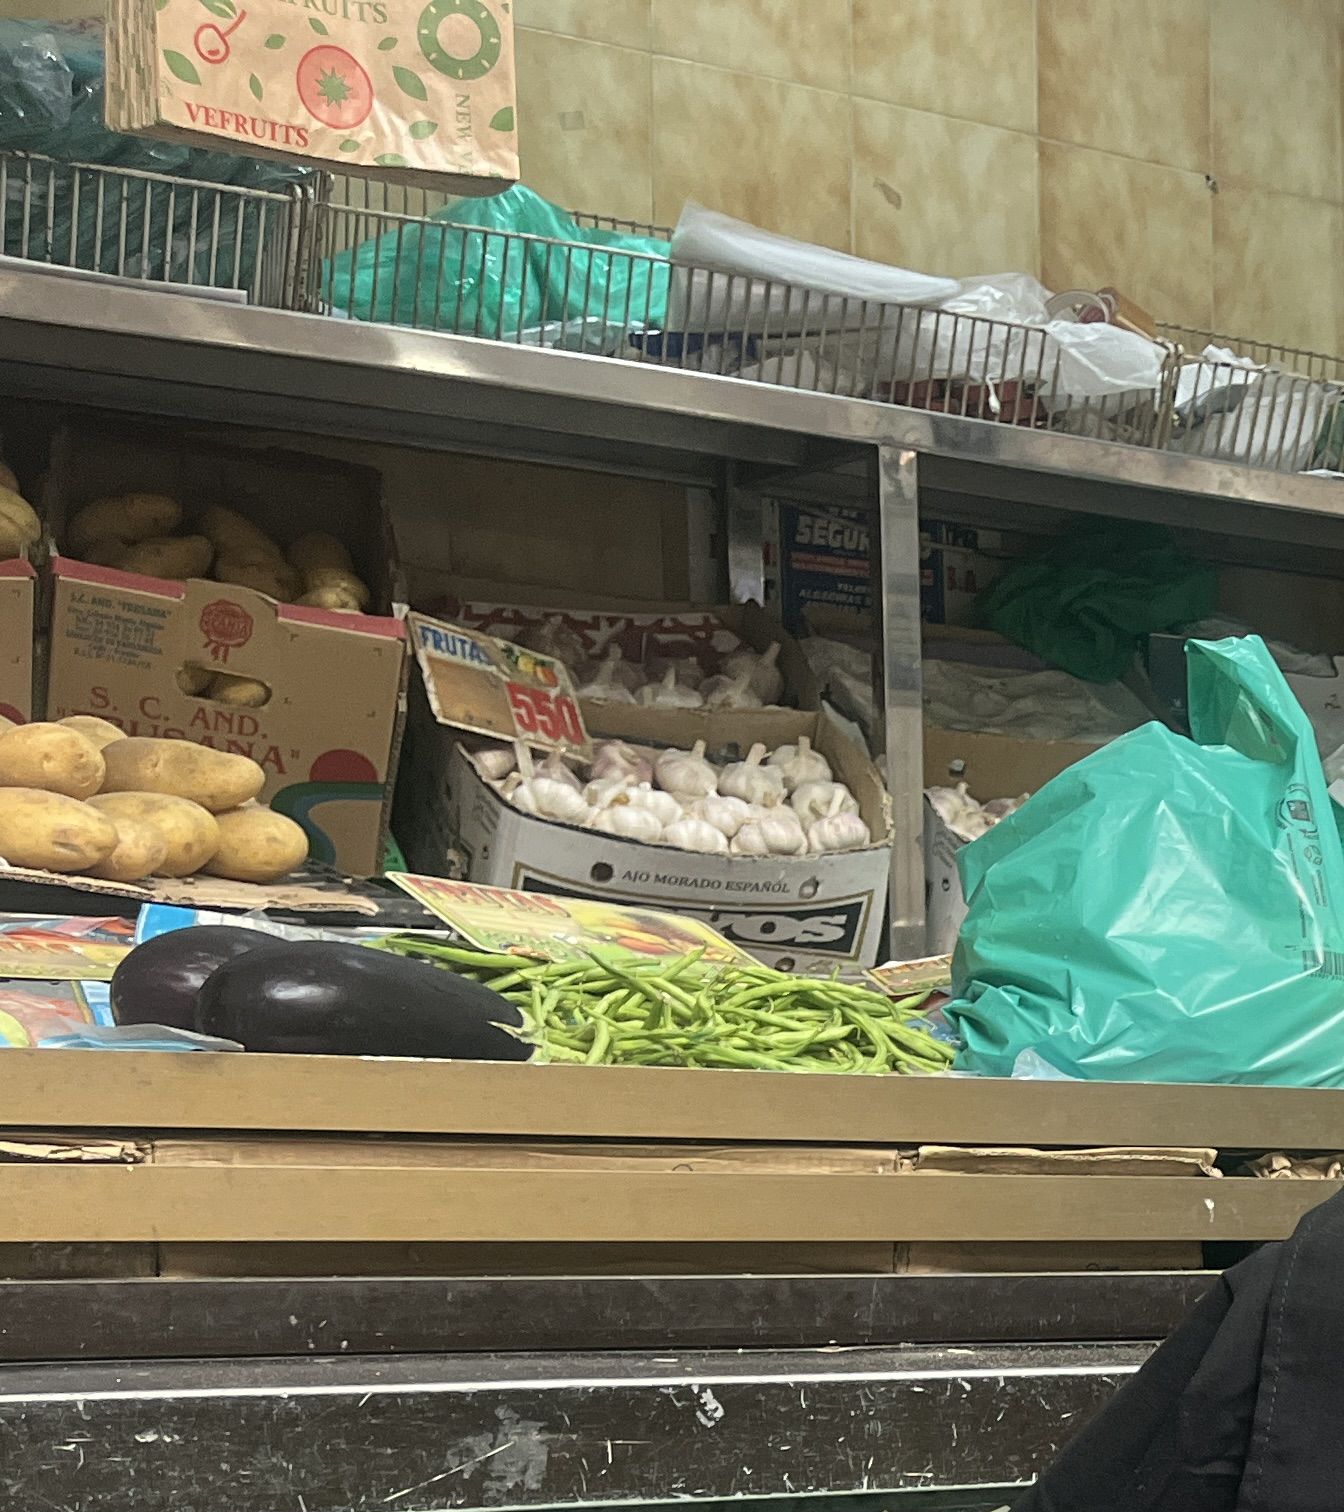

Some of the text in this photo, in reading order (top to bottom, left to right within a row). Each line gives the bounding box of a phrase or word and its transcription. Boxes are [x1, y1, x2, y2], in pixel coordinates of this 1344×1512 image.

[183, 101, 310, 149] VEFRUITS
[90, 685, 269, 740] S. C. AND.
[506, 680, 586, 747] 550
[621, 870, 650, 883] AJO
[653, 872, 722, 891] MORADO
